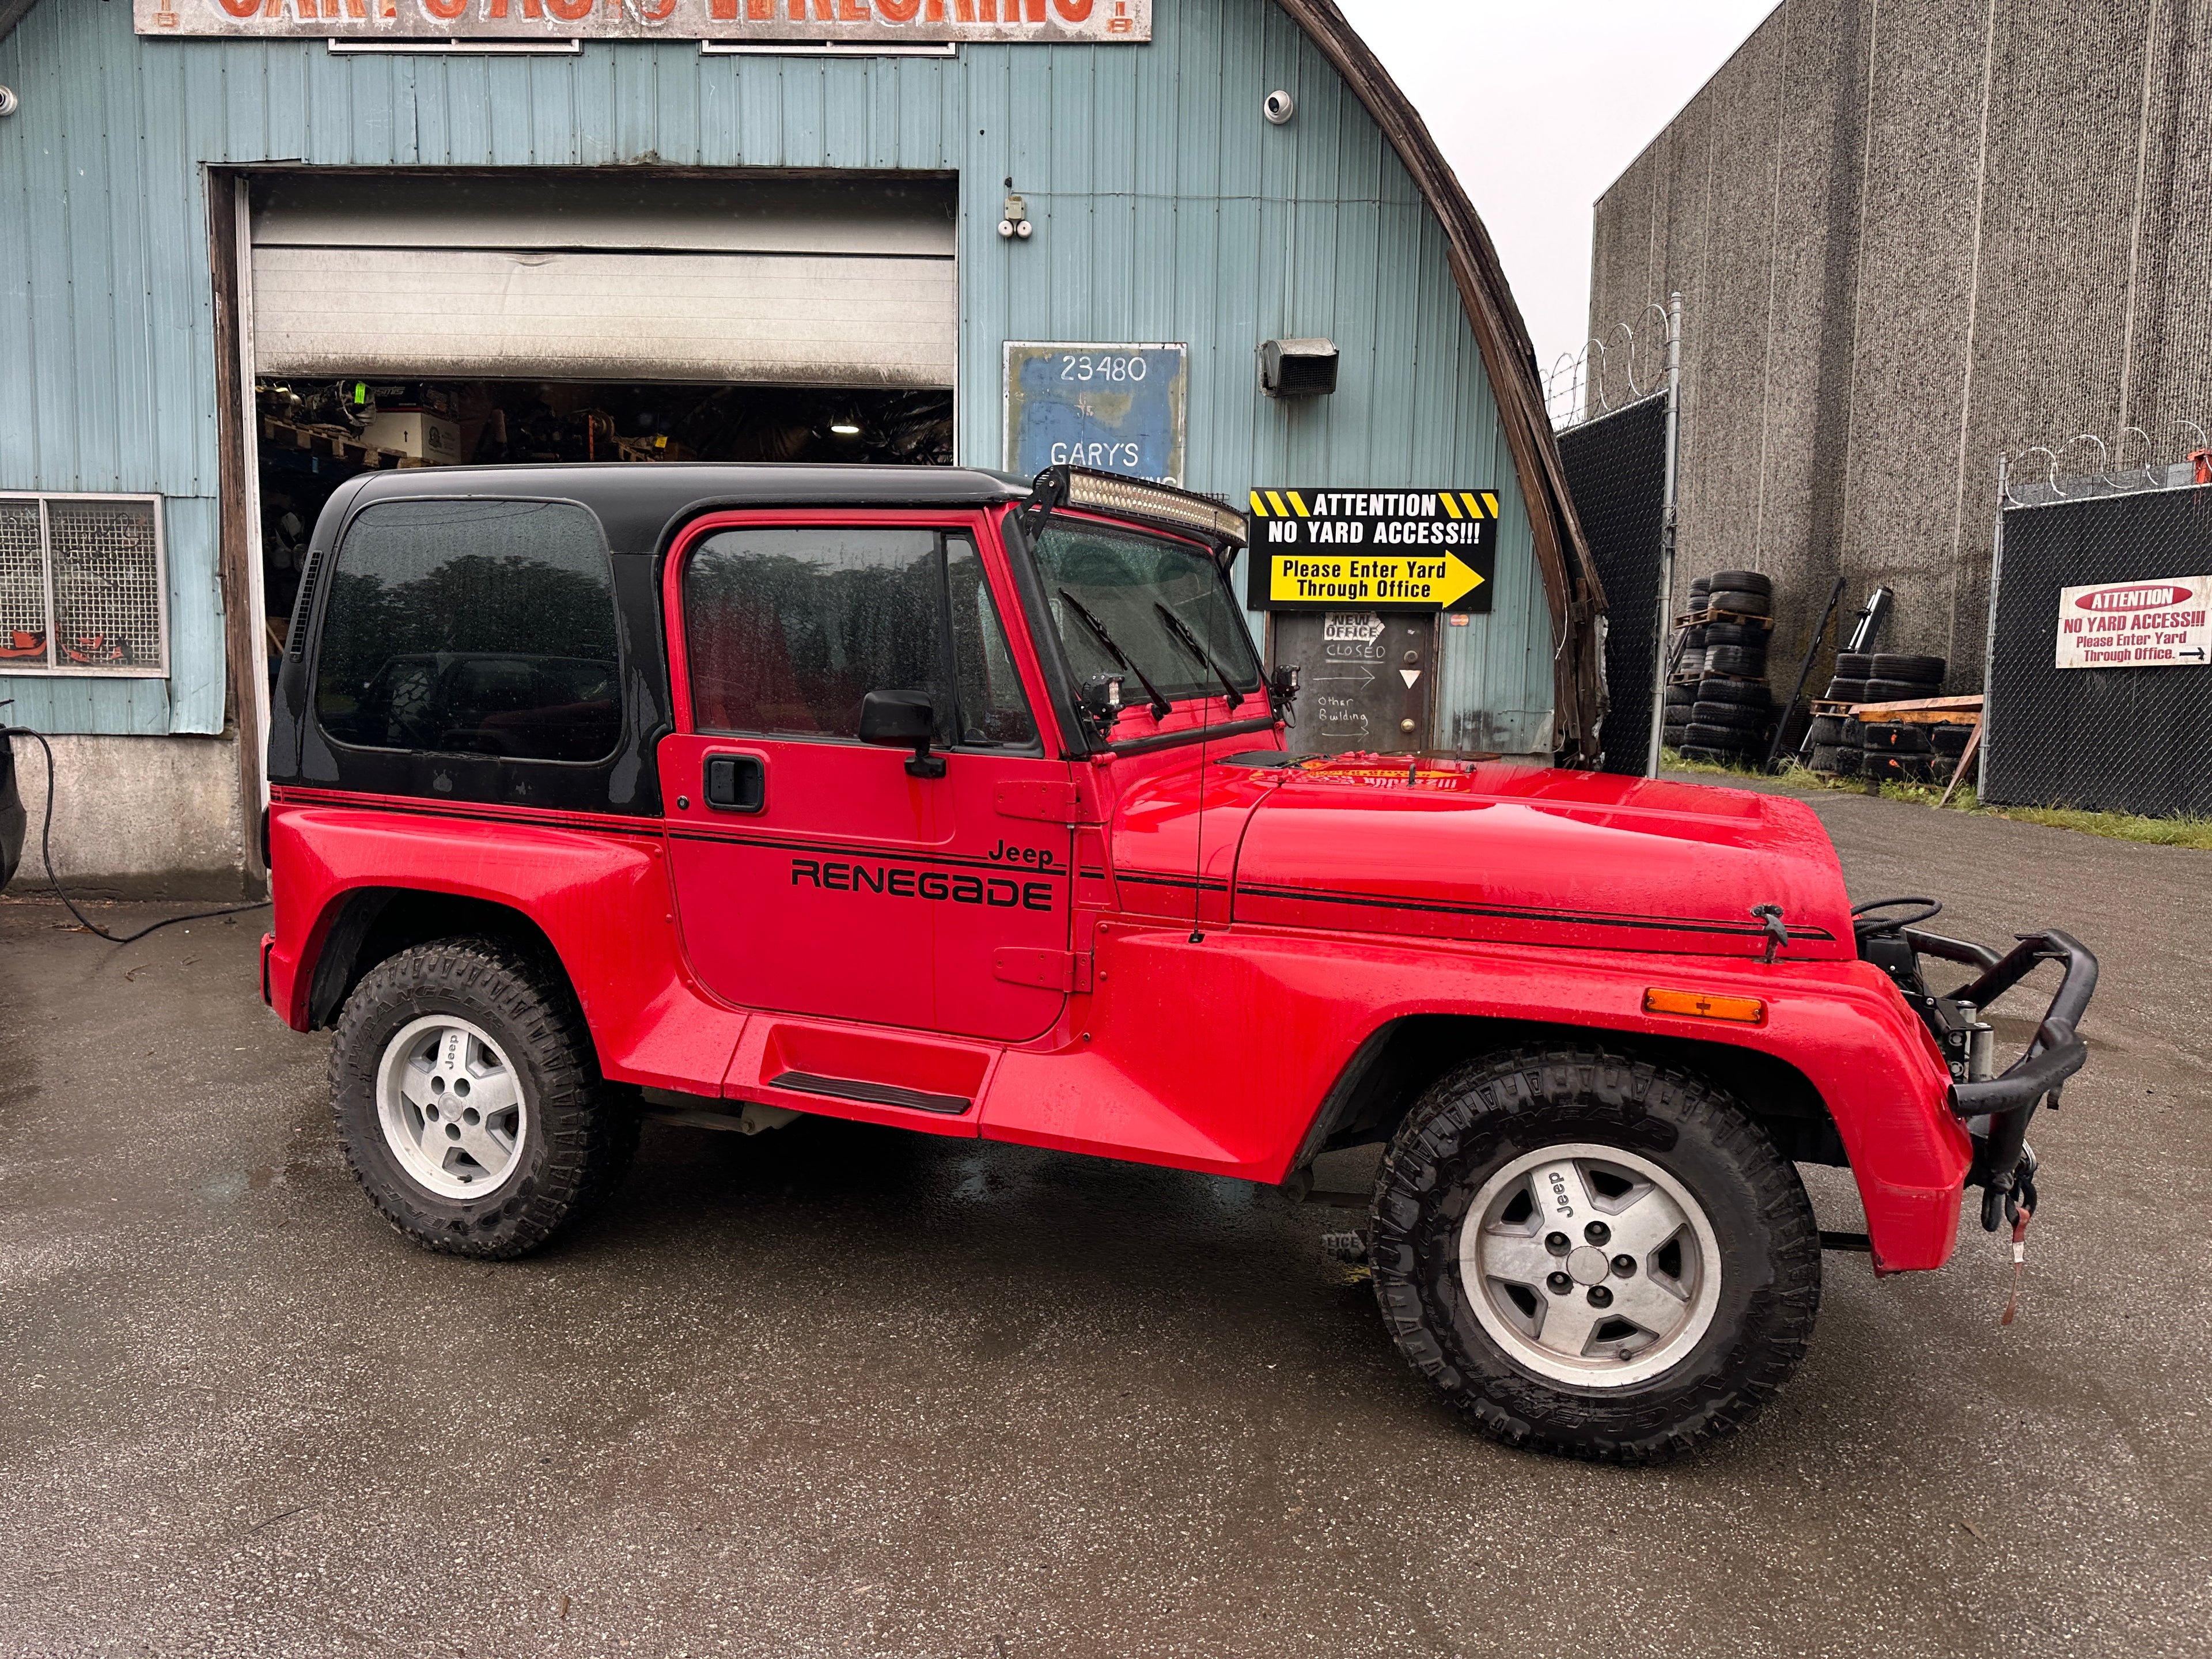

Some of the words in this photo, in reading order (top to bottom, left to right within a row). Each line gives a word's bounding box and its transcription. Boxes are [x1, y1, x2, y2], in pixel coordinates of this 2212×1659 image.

[1060, 355, 1147, 381] 23480
[1050, 442, 1139, 467] GARY'S
[1313, 493, 1436, 517] ATTENTION
[1268, 521, 1298, 543] NO
[1308, 521, 1363, 544] YARD
[1373, 522, 1480, 544] ACCESS!!!
[1283, 560, 1340, 578] Please
[1350, 560, 1398, 578] Enter
[1407, 561, 1446, 579] Yard
[1297, 579, 1368, 600] Through
[1377, 581, 1431, 597] Office
[2091, 588, 2174, 609] ATTENTION
[1334, 615, 1369, 625] NEW
[2063, 618, 2083, 634] NO
[2087, 615, 2127, 632] YARD
[2130, 611, 2206, 630] ACCESS!!!
[1326, 626, 1377, 637] OFFICE
[2076, 636, 2113, 648] Please
[2116, 634, 2151, 646] Enter
[2155, 631, 2187, 645] Yard
[1327, 644, 1385, 658] CLOSED
[2084, 648, 2131, 662] Through
[2134, 647, 2175, 660] Office.
[1319, 708, 1368, 728] Building
[988, 839, 1054, 870] Jeep
[445, 1035, 459, 1070] Jeep
[1548, 1172, 1574, 1218] Jeep
